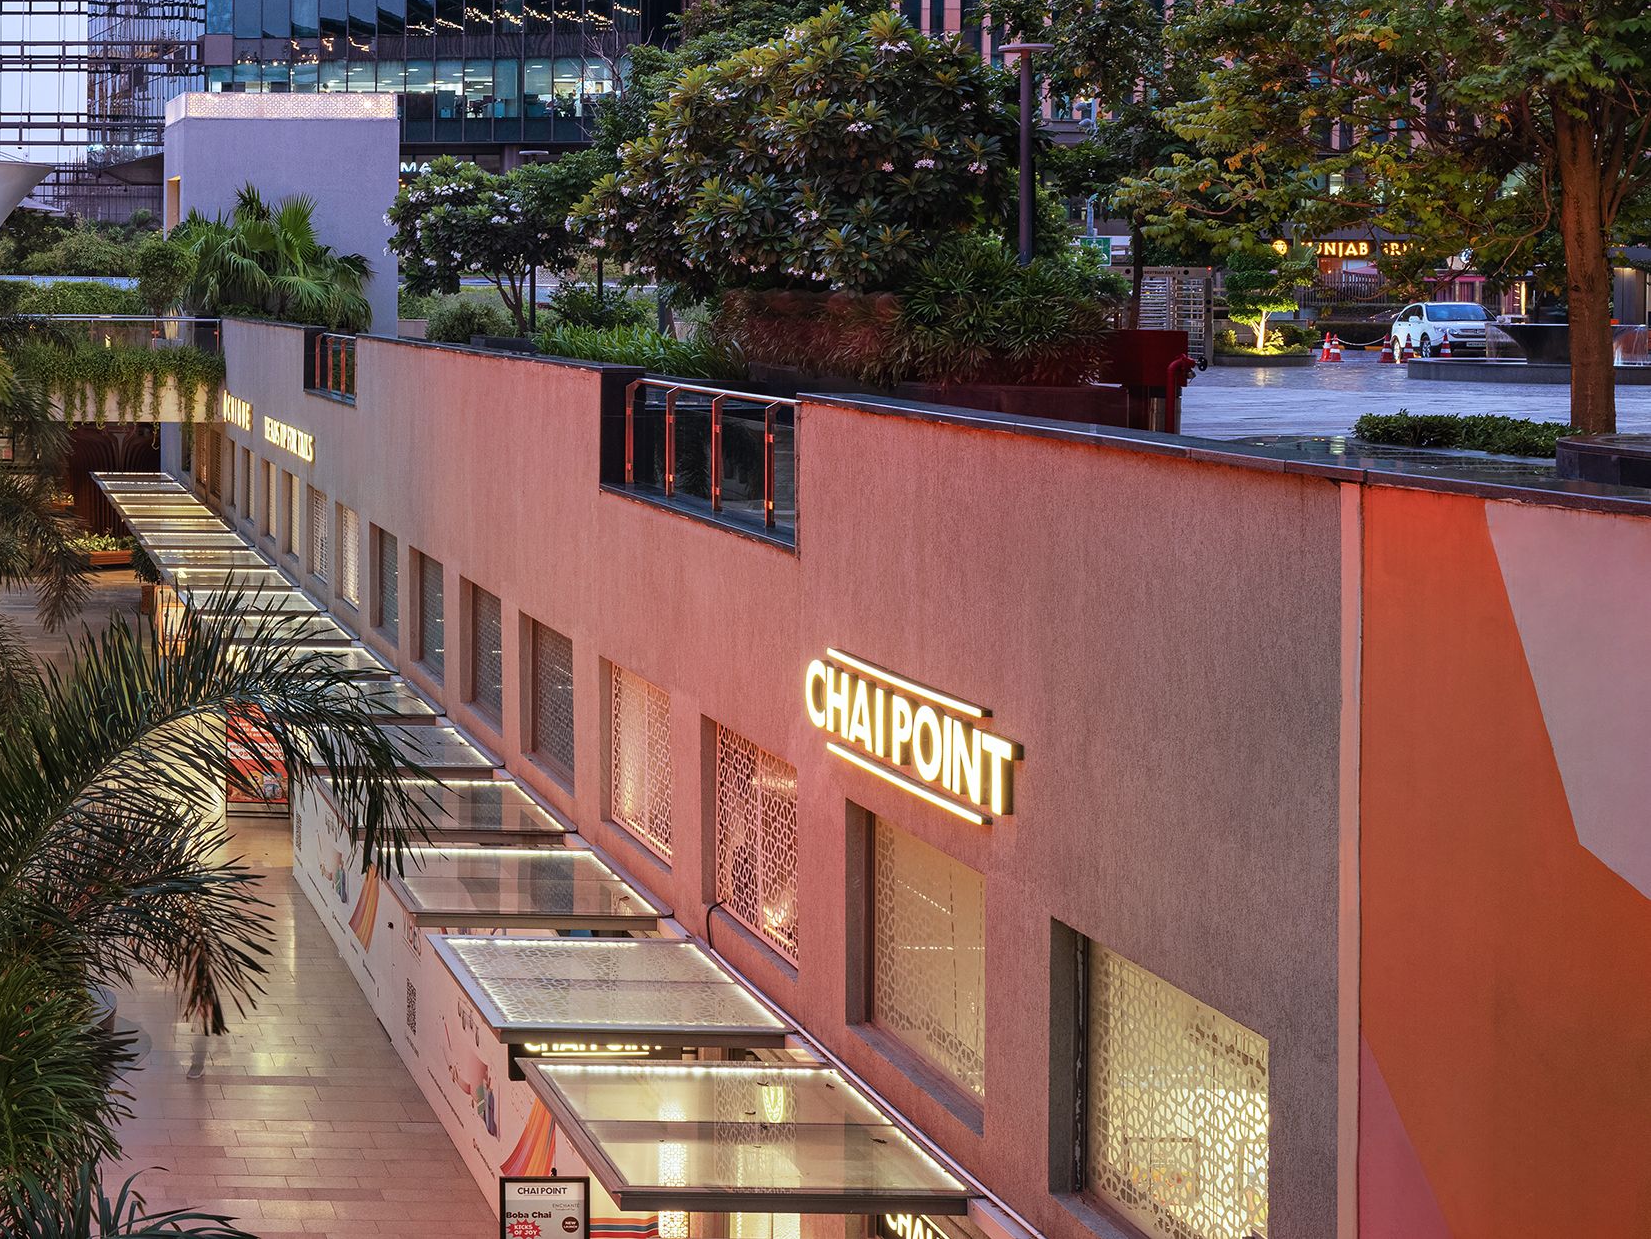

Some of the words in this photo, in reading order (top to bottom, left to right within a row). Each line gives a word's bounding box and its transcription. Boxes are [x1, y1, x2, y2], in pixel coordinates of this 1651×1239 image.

[806, 660, 887, 759] CHAI
[891, 694, 1017, 816] POINT
[517, 1187, 539, 1195] CHAI
[540, 1187, 567, 1195] POINT
